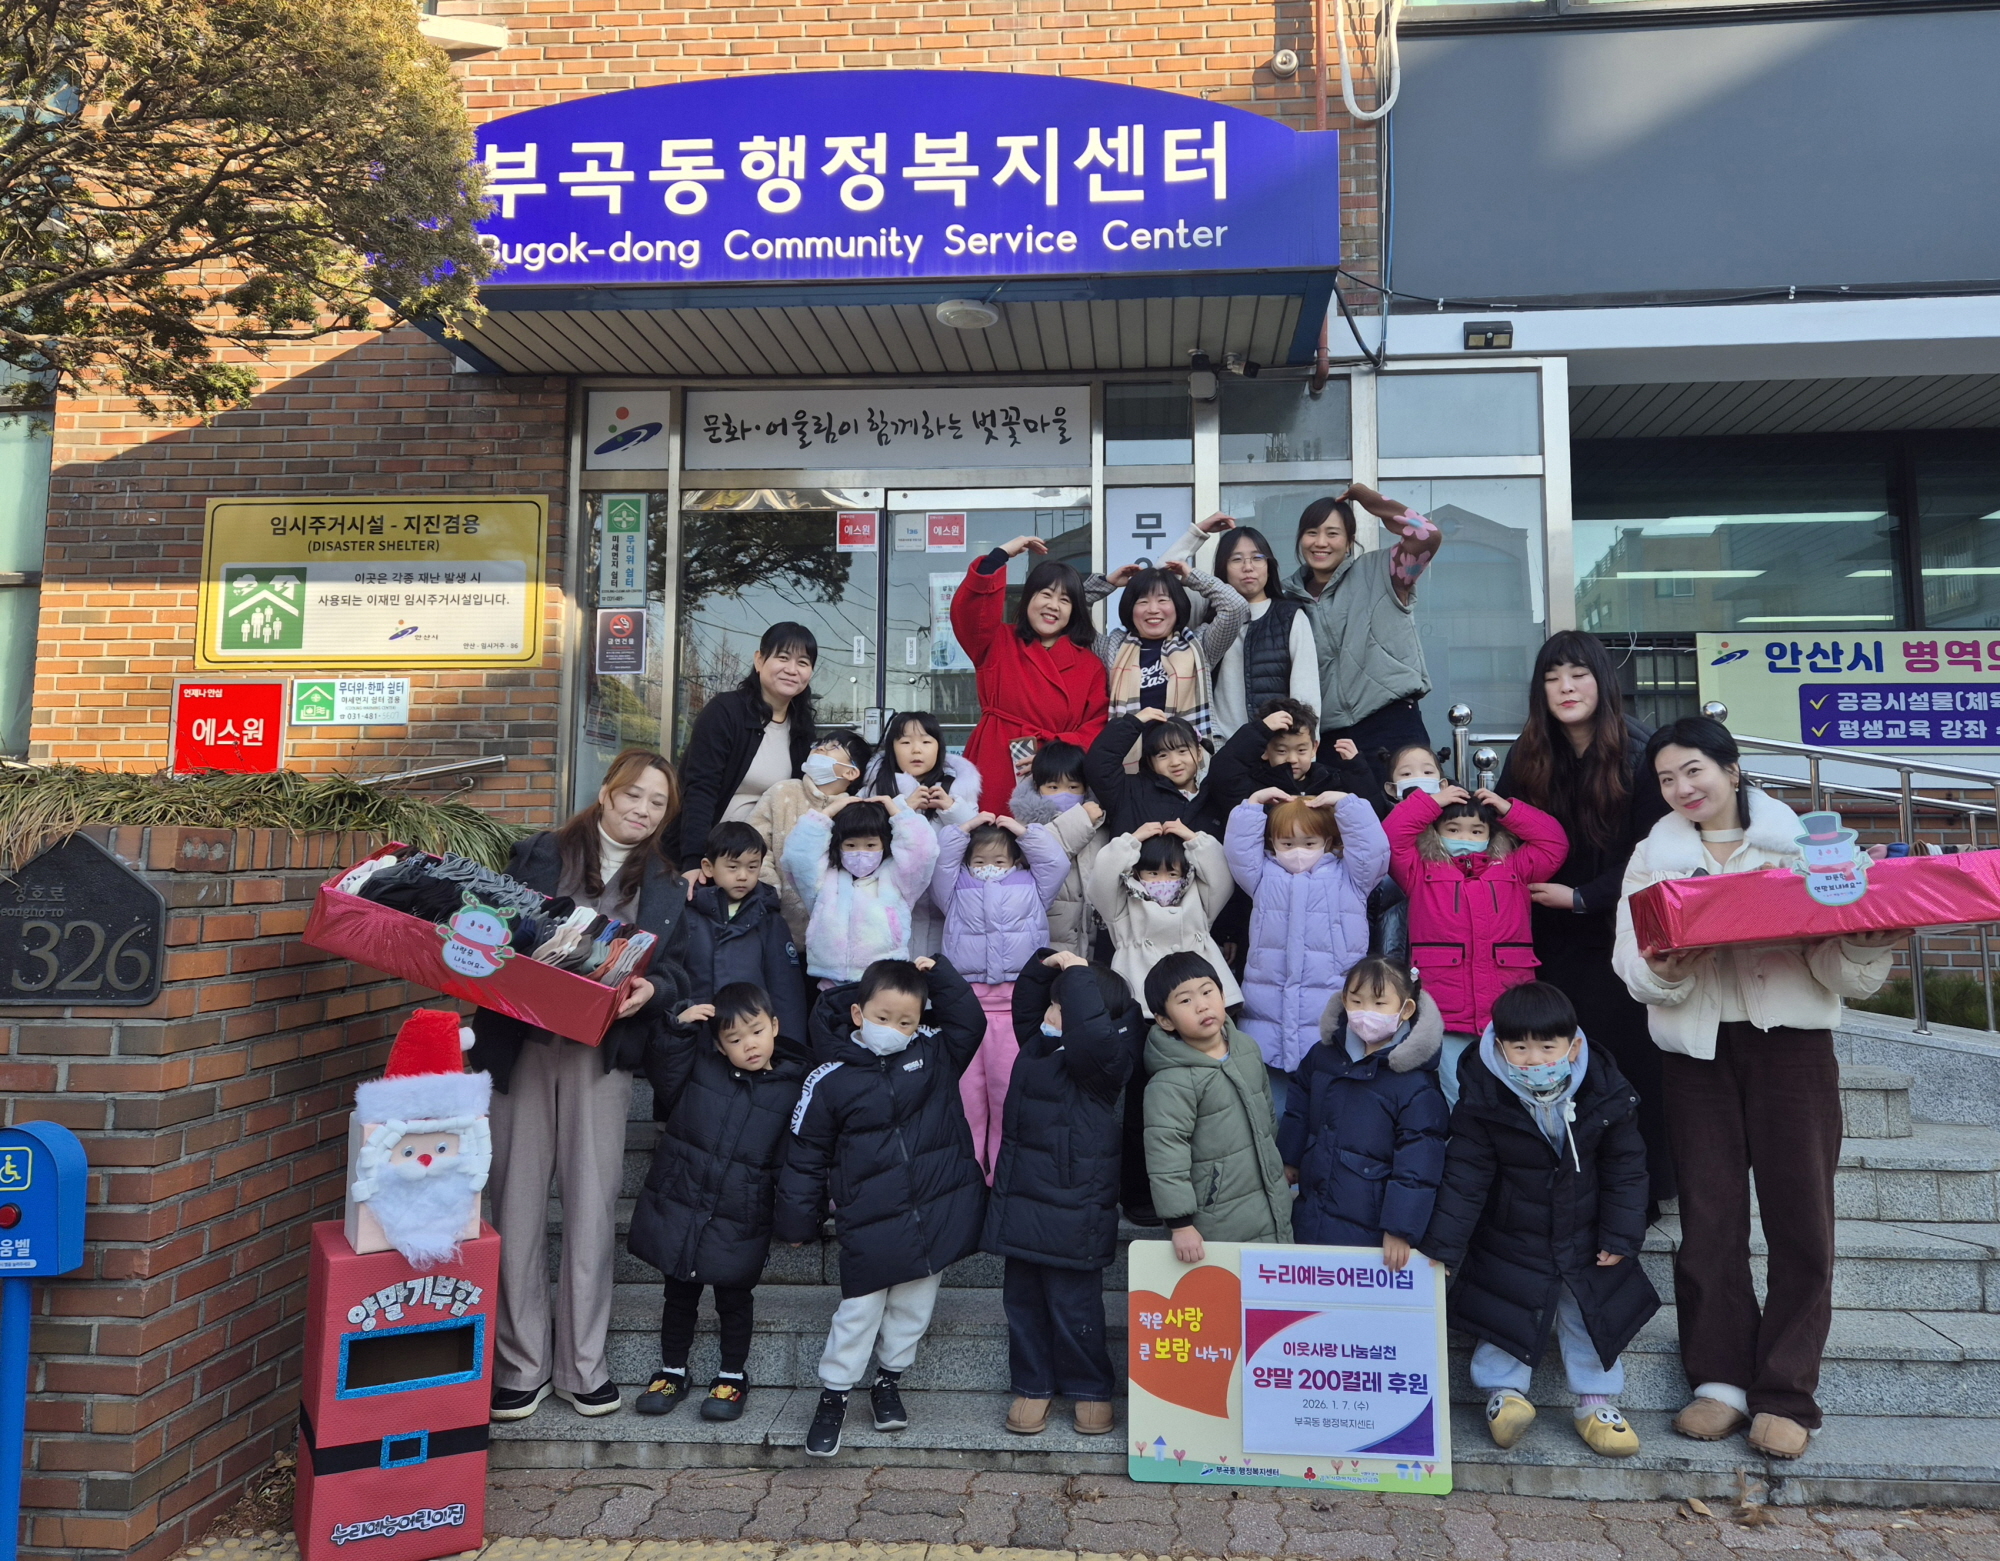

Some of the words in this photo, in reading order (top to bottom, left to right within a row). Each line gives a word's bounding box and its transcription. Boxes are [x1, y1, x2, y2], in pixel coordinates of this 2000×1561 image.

[483, 121, 1228, 219] 부곡동행정복지센터
[478, 231, 701, 271] Bugok-dong
[723, 226, 924, 262] Community
[944, 223, 1078, 257] Service
[1102, 219, 1229, 250] Center
[702, 409, 859, 449] 문화·어울림이
[867, 407, 963, 446] 함께하는
[972, 405, 1072, 448] 벚꽃마을
[270, 515, 385, 536] 임시주거시설
[403, 514, 480, 535] 지진겸용
[844, 524, 871, 536] 에스원
[933, 525, 960, 536] 에스원
[307, 541, 375, 554] (DISASTER
[378, 539, 441, 553] SHELTER)
[611, 534, 620, 569] 미세먼지
[625, 534, 635, 565] 무더위
[354, 572, 388, 584] 이곳은
[391, 572, 415, 584] 각종
[417, 571, 441, 584] 재난
[444, 571, 467, 584] 발생
[470, 571, 482, 583] 시
[610, 570, 619, 588] 쉼터
[625, 567, 635, 588] 쉼터
[317, 594, 363, 607] 사용되는
[366, 594, 401, 606] 이재민
[404, 593, 510, 606] 임시주거시설입니다.
[462, 642, 476, 650] 안산
[480, 642, 506, 650] 임시거주
[510, 642, 519, 650] 86
[1765, 640, 1884, 673] 안산시
[183, 688, 207, 698] 언제나
[207, 688, 223, 698] 안심
[338, 681, 385, 696] 무더위·한파
[386, 681, 405, 695] 쉼터
[341, 696, 369, 705] 미세먼지
[371, 696, 385, 704] 쉼터
[387, 695, 401, 704] 겸용
[191, 717, 265, 746] 에스원
[1838, 719, 1931, 739] 평생교육
[1940, 719, 1988, 739] 강좌
[11, 883, 67, 903] 성호로
[11, 919, 152, 992] 326
[1258, 1263, 1414, 1290] 누리예능어린이집
[347, 1275, 484, 1332] 양말기부함
[1139, 1311, 1164, 1330] 작은
[1164, 1307, 1204, 1333] 사랑
[1139, 1343, 1151, 1361] 큰
[1154, 1337, 1192, 1363] 보람
[1195, 1345, 1232, 1363] 나누기
[1283, 1341, 1338, 1357] 이웃사랑
[1341, 1344, 1397, 1360] 나눔실천
[1252, 1366, 1293, 1390] 양말
[1298, 1369, 1382, 1393] 200켤레
[1387, 1371, 1429, 1395] 후원
[1302, 1399, 1328, 1410] 2026.
[1332, 1400, 1339, 1410] 1.
[1342, 1401, 1350, 1410] 7.
[1354, 1400, 1370, 1411] (수)
[1294, 1417, 1320, 1428] 부곡동
[1322, 1417, 1375, 1430] 행정복지센터
[1216, 1466, 1236, 1475] 부곡동
[1239, 1467, 1280, 1477] 행정복지센터
